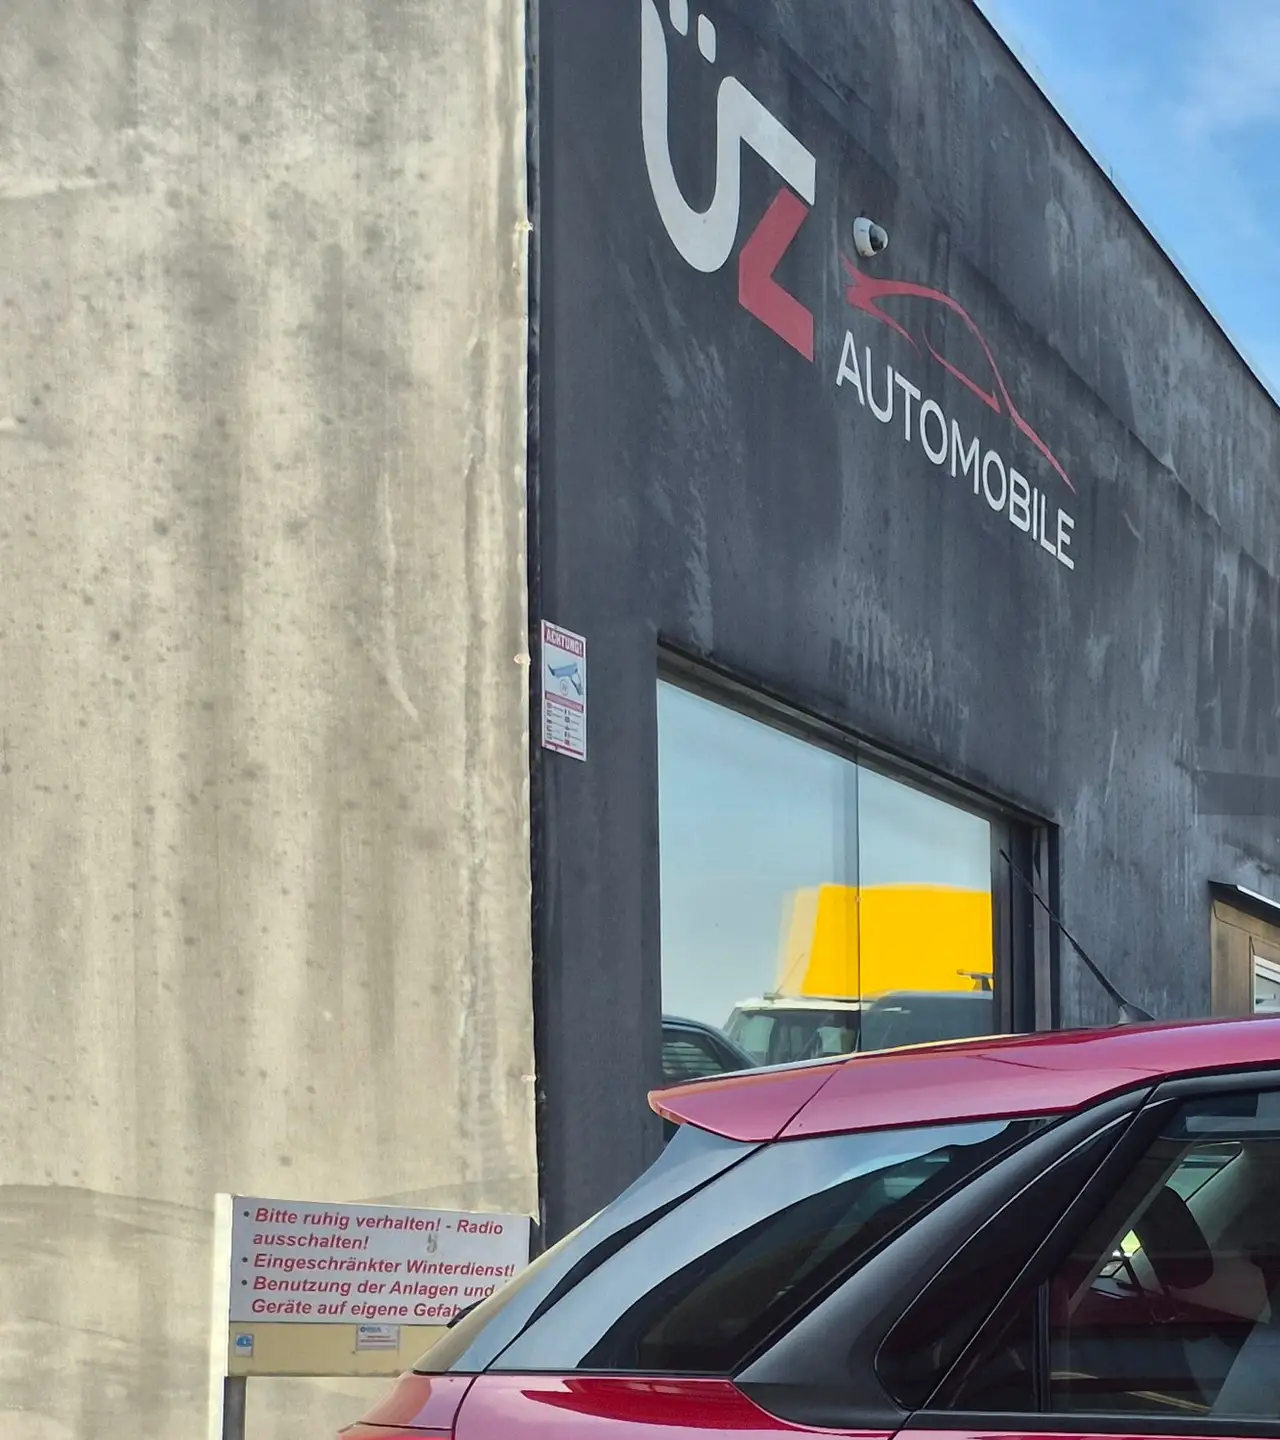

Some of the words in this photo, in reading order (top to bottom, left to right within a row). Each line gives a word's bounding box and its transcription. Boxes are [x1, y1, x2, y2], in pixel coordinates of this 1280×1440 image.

[836, 330, 1075, 570] AUTOMOBILE
[546, 628, 583, 655] ACHTUNG!
[255, 1207, 298, 1224] Bitte
[303, 1212, 350, 1230] ruhig
[356, 1215, 441, 1232] verhalten!
[457, 1219, 504, 1235] Radio
[253, 1232, 369, 1250] ausschalten!
[254, 1253, 402, 1273] Eingeschränkter
[406, 1259, 515, 1277] Winterdienst!
[253, 1275, 351, 1297] Benutzung
[357, 1280, 386, 1294] der
[389, 1280, 458, 1299] Anlagen
[463, 1284, 495, 1297] und
[252, 1298, 312, 1314] Geräte
[317, 1300, 348, 1315] auf
[351, 1302, 408, 1319] eigene
[413, 1303, 463, 1318] Gefah
